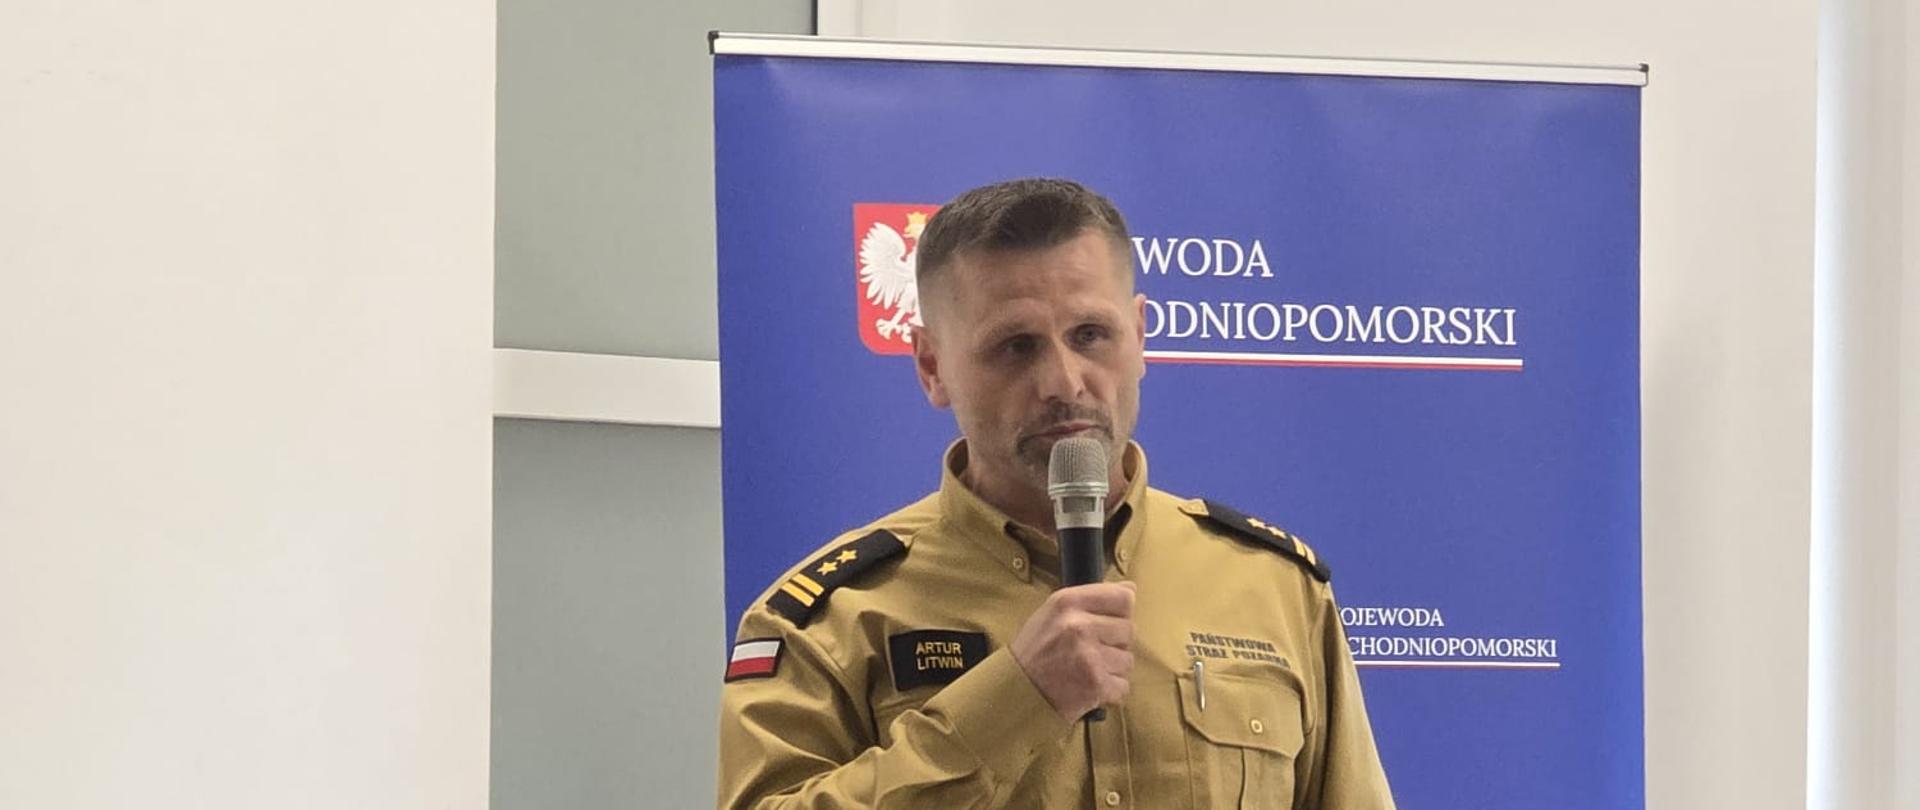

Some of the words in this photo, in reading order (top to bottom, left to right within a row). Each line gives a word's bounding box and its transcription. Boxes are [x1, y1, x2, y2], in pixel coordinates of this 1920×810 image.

[1131, 236, 1274, 277] WODA
[1338, 606, 1445, 627] OJEWODA
[915, 642, 962, 655] ARTUR
[917, 656, 964, 670] LITWIN
